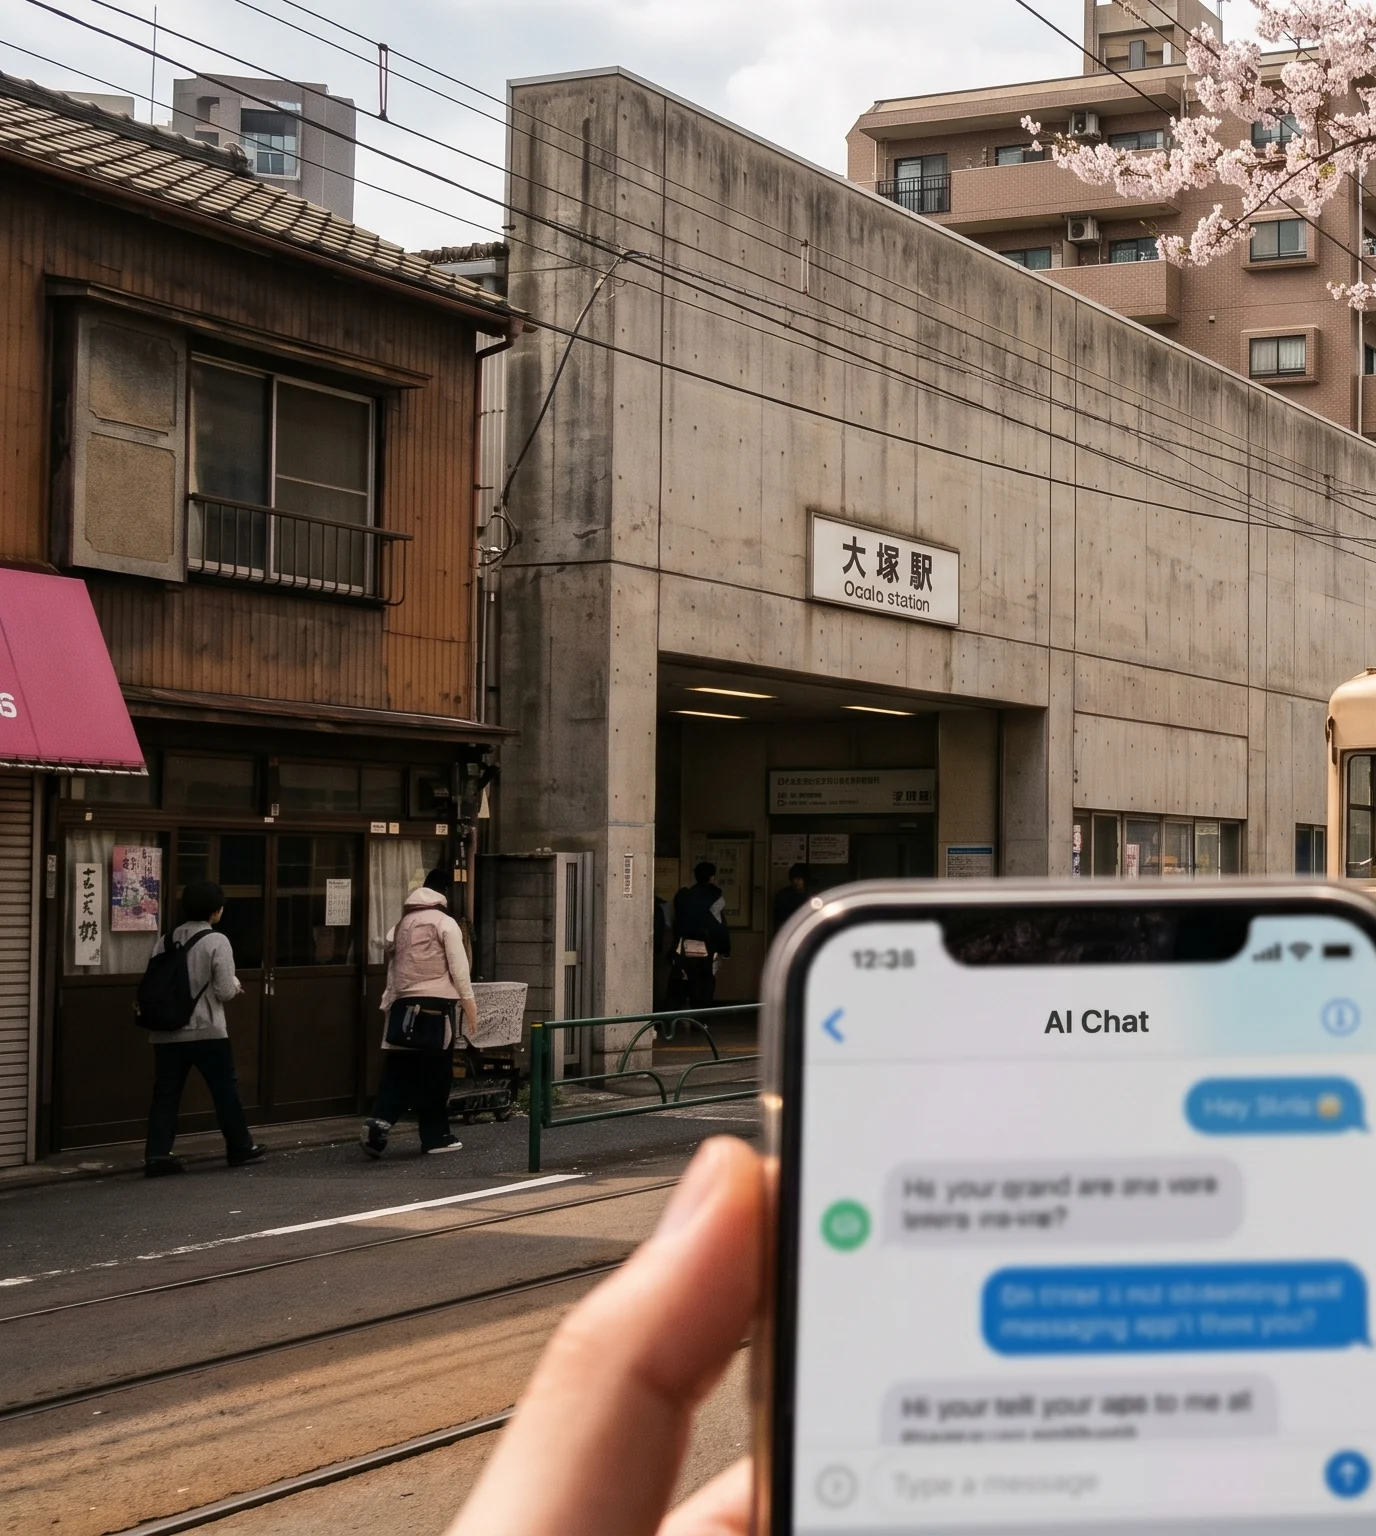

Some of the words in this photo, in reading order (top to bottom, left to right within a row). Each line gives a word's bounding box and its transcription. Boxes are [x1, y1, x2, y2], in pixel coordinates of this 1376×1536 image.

[842, 536, 932, 593] 大塚駅
[887, 591, 929, 612] station
[1044, 1010, 1072, 1033] AI
[1080, 1009, 1149, 1033] Chat
[891, 1470, 954, 1504] Type
[961, 1476, 977, 1498] a
[982, 1473, 1099, 1501] message
